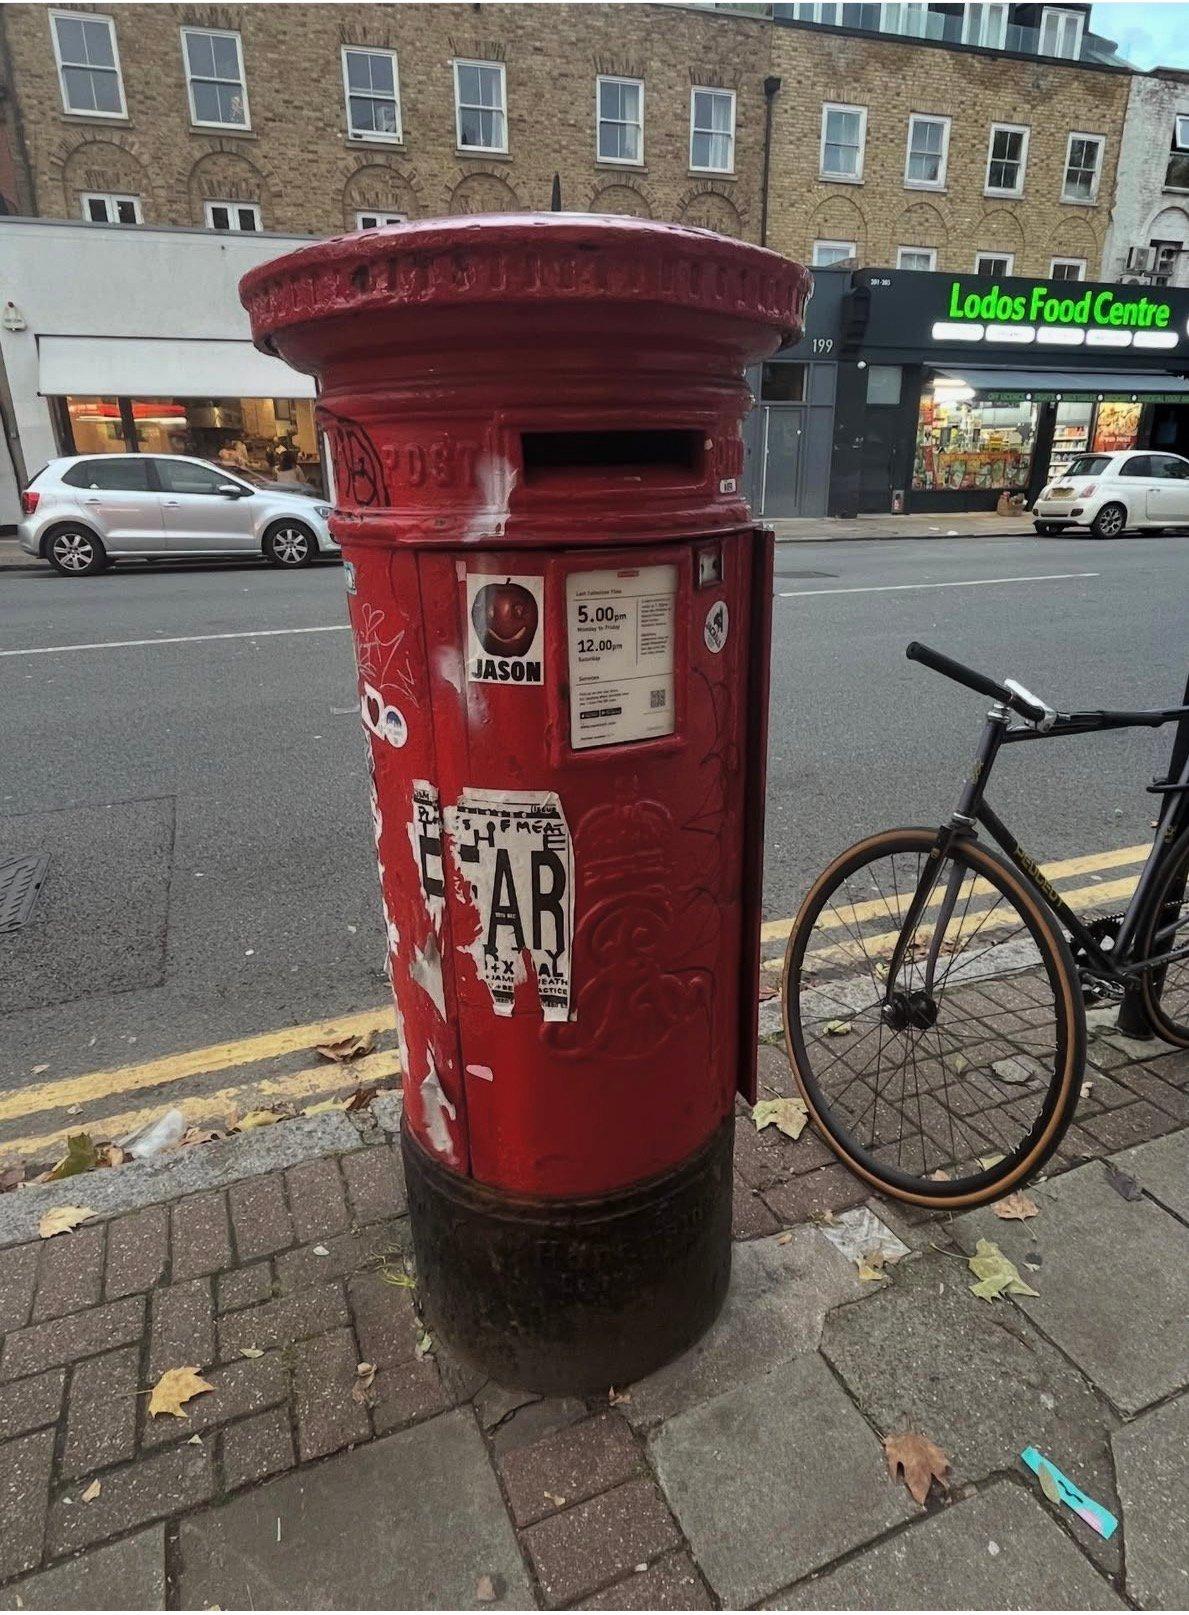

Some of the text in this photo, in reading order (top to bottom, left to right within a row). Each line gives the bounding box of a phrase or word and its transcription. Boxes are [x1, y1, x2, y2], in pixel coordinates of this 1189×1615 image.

[949, 282, 1171, 327] Lodos Food Centre
[812, 338, 834, 353] 199
[578, 604, 627, 623] 5.00pm
[578, 638, 623, 653] 12.00pm
[471, 658, 541, 683] JASON
